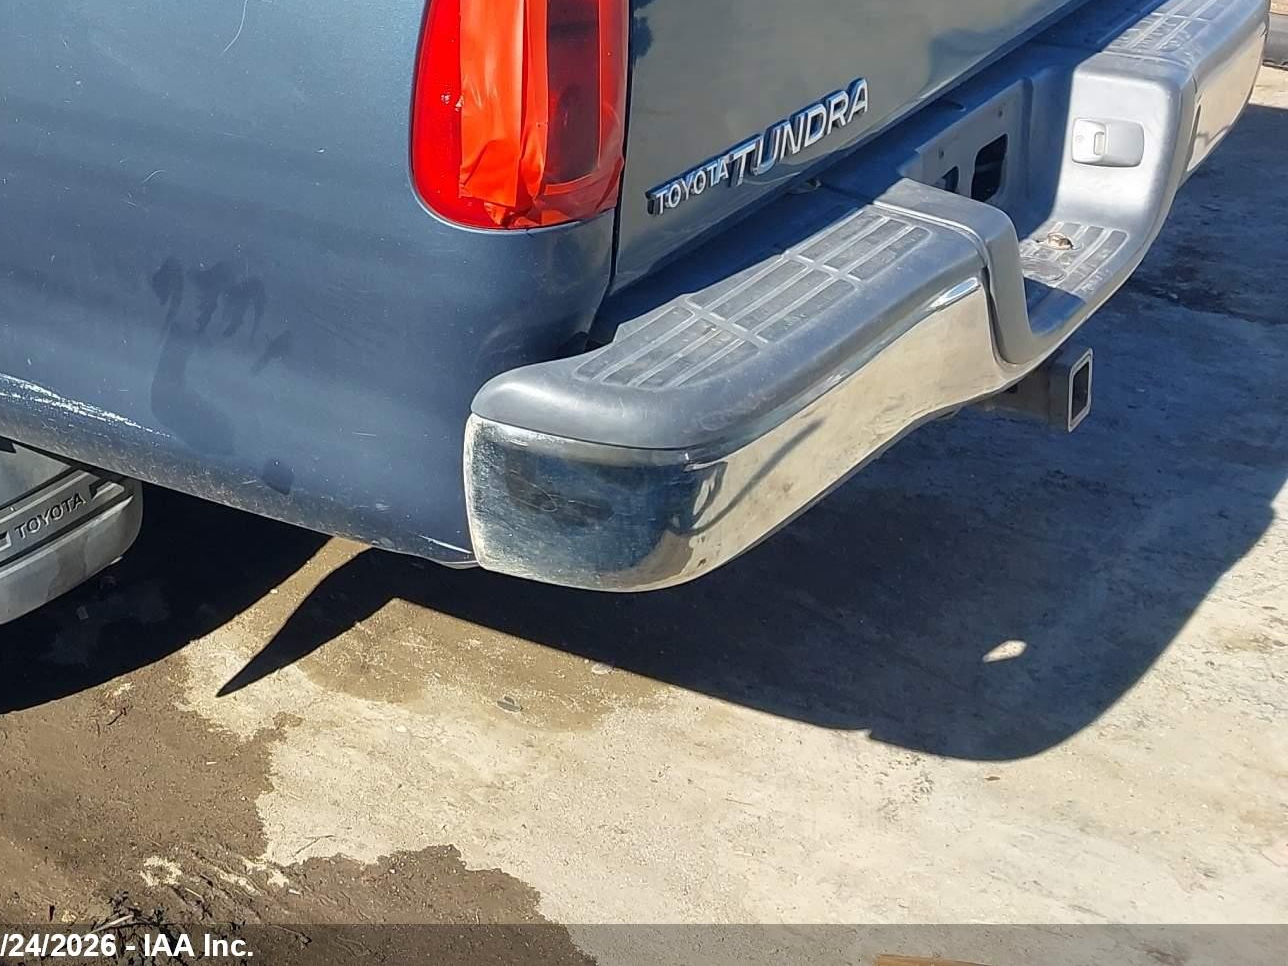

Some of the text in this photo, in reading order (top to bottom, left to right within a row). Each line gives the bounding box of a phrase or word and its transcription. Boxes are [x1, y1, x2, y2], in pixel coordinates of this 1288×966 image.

[646, 77, 869, 215] TOYOTA TUNDRA
[14, 493, 86, 539] TOYOTA
